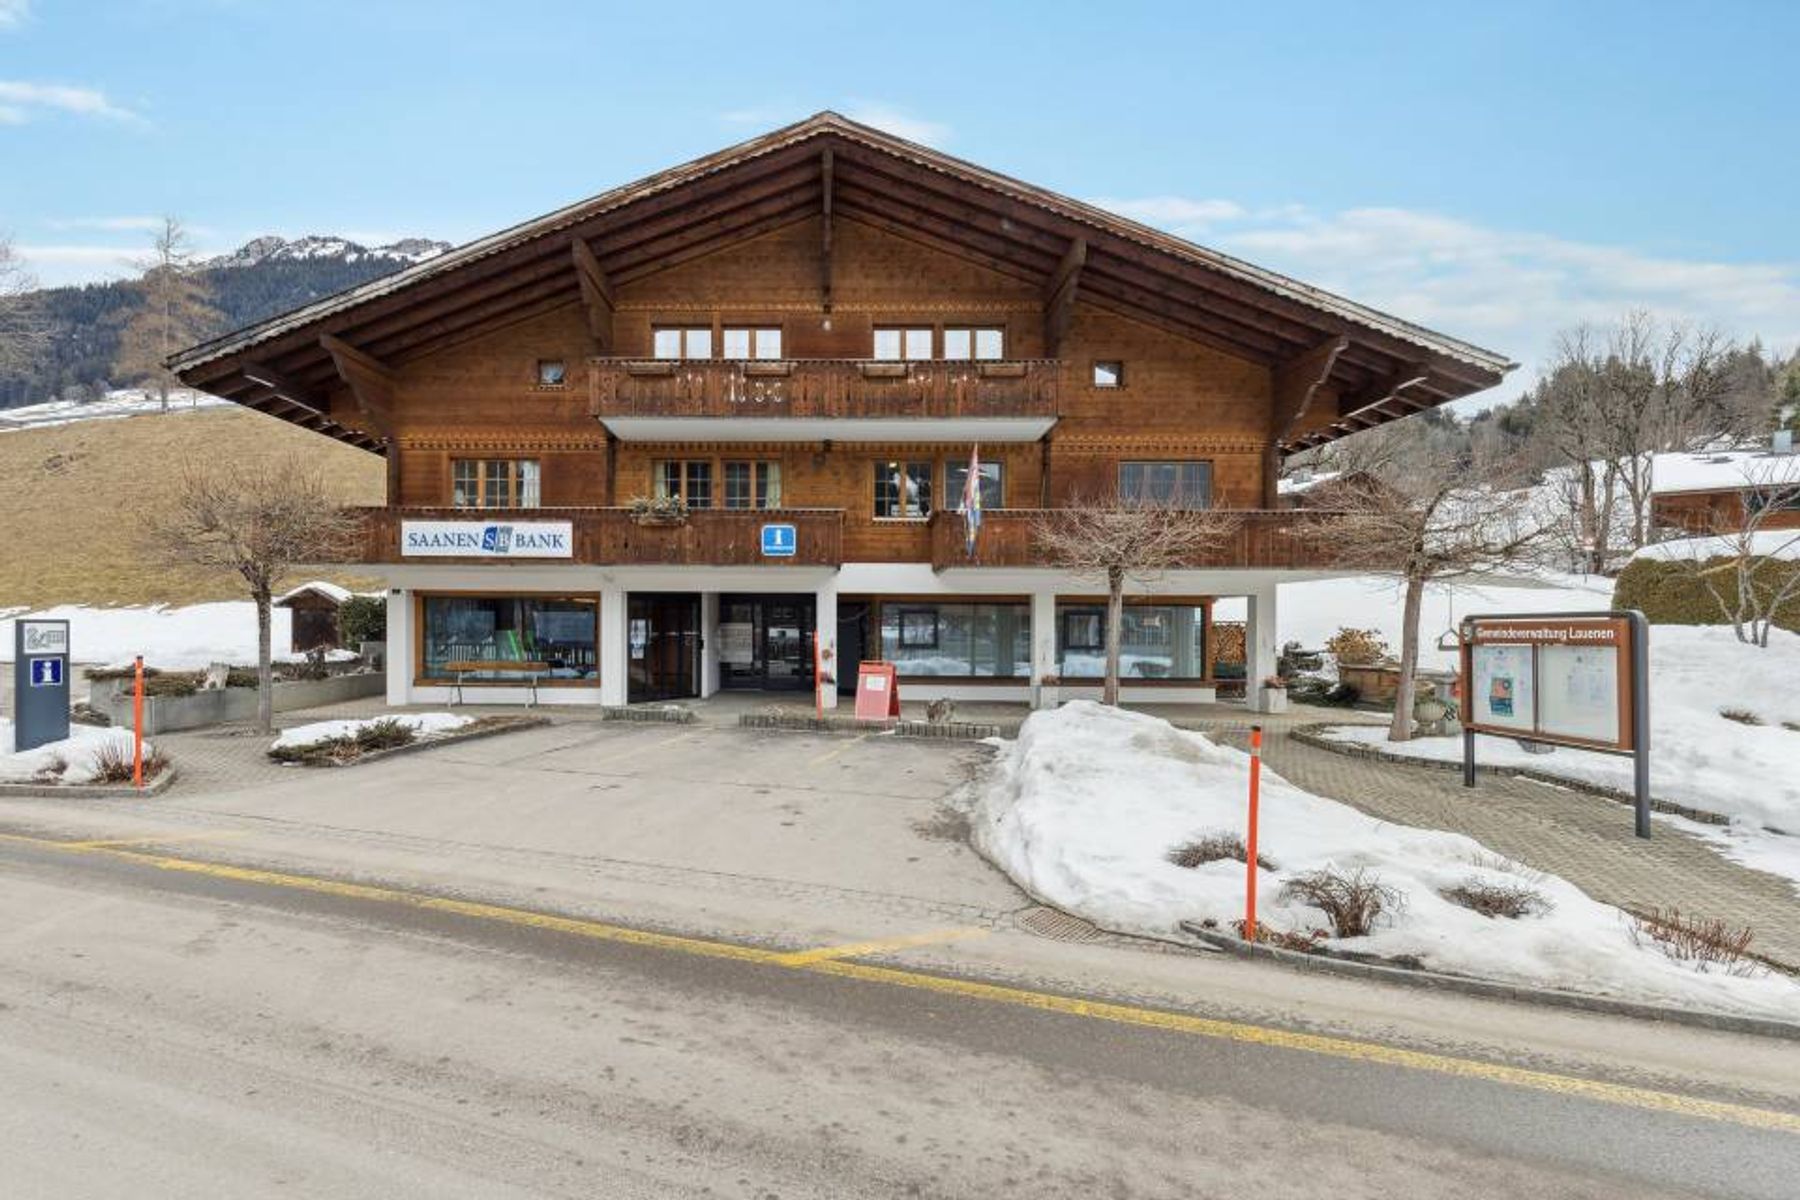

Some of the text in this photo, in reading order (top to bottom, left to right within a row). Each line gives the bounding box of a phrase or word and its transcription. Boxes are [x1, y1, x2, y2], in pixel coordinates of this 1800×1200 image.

[408, 533, 480, 547] SAANEN
[515, 533, 564, 548] BANK
[1569, 626, 1614, 639] Lauenen
